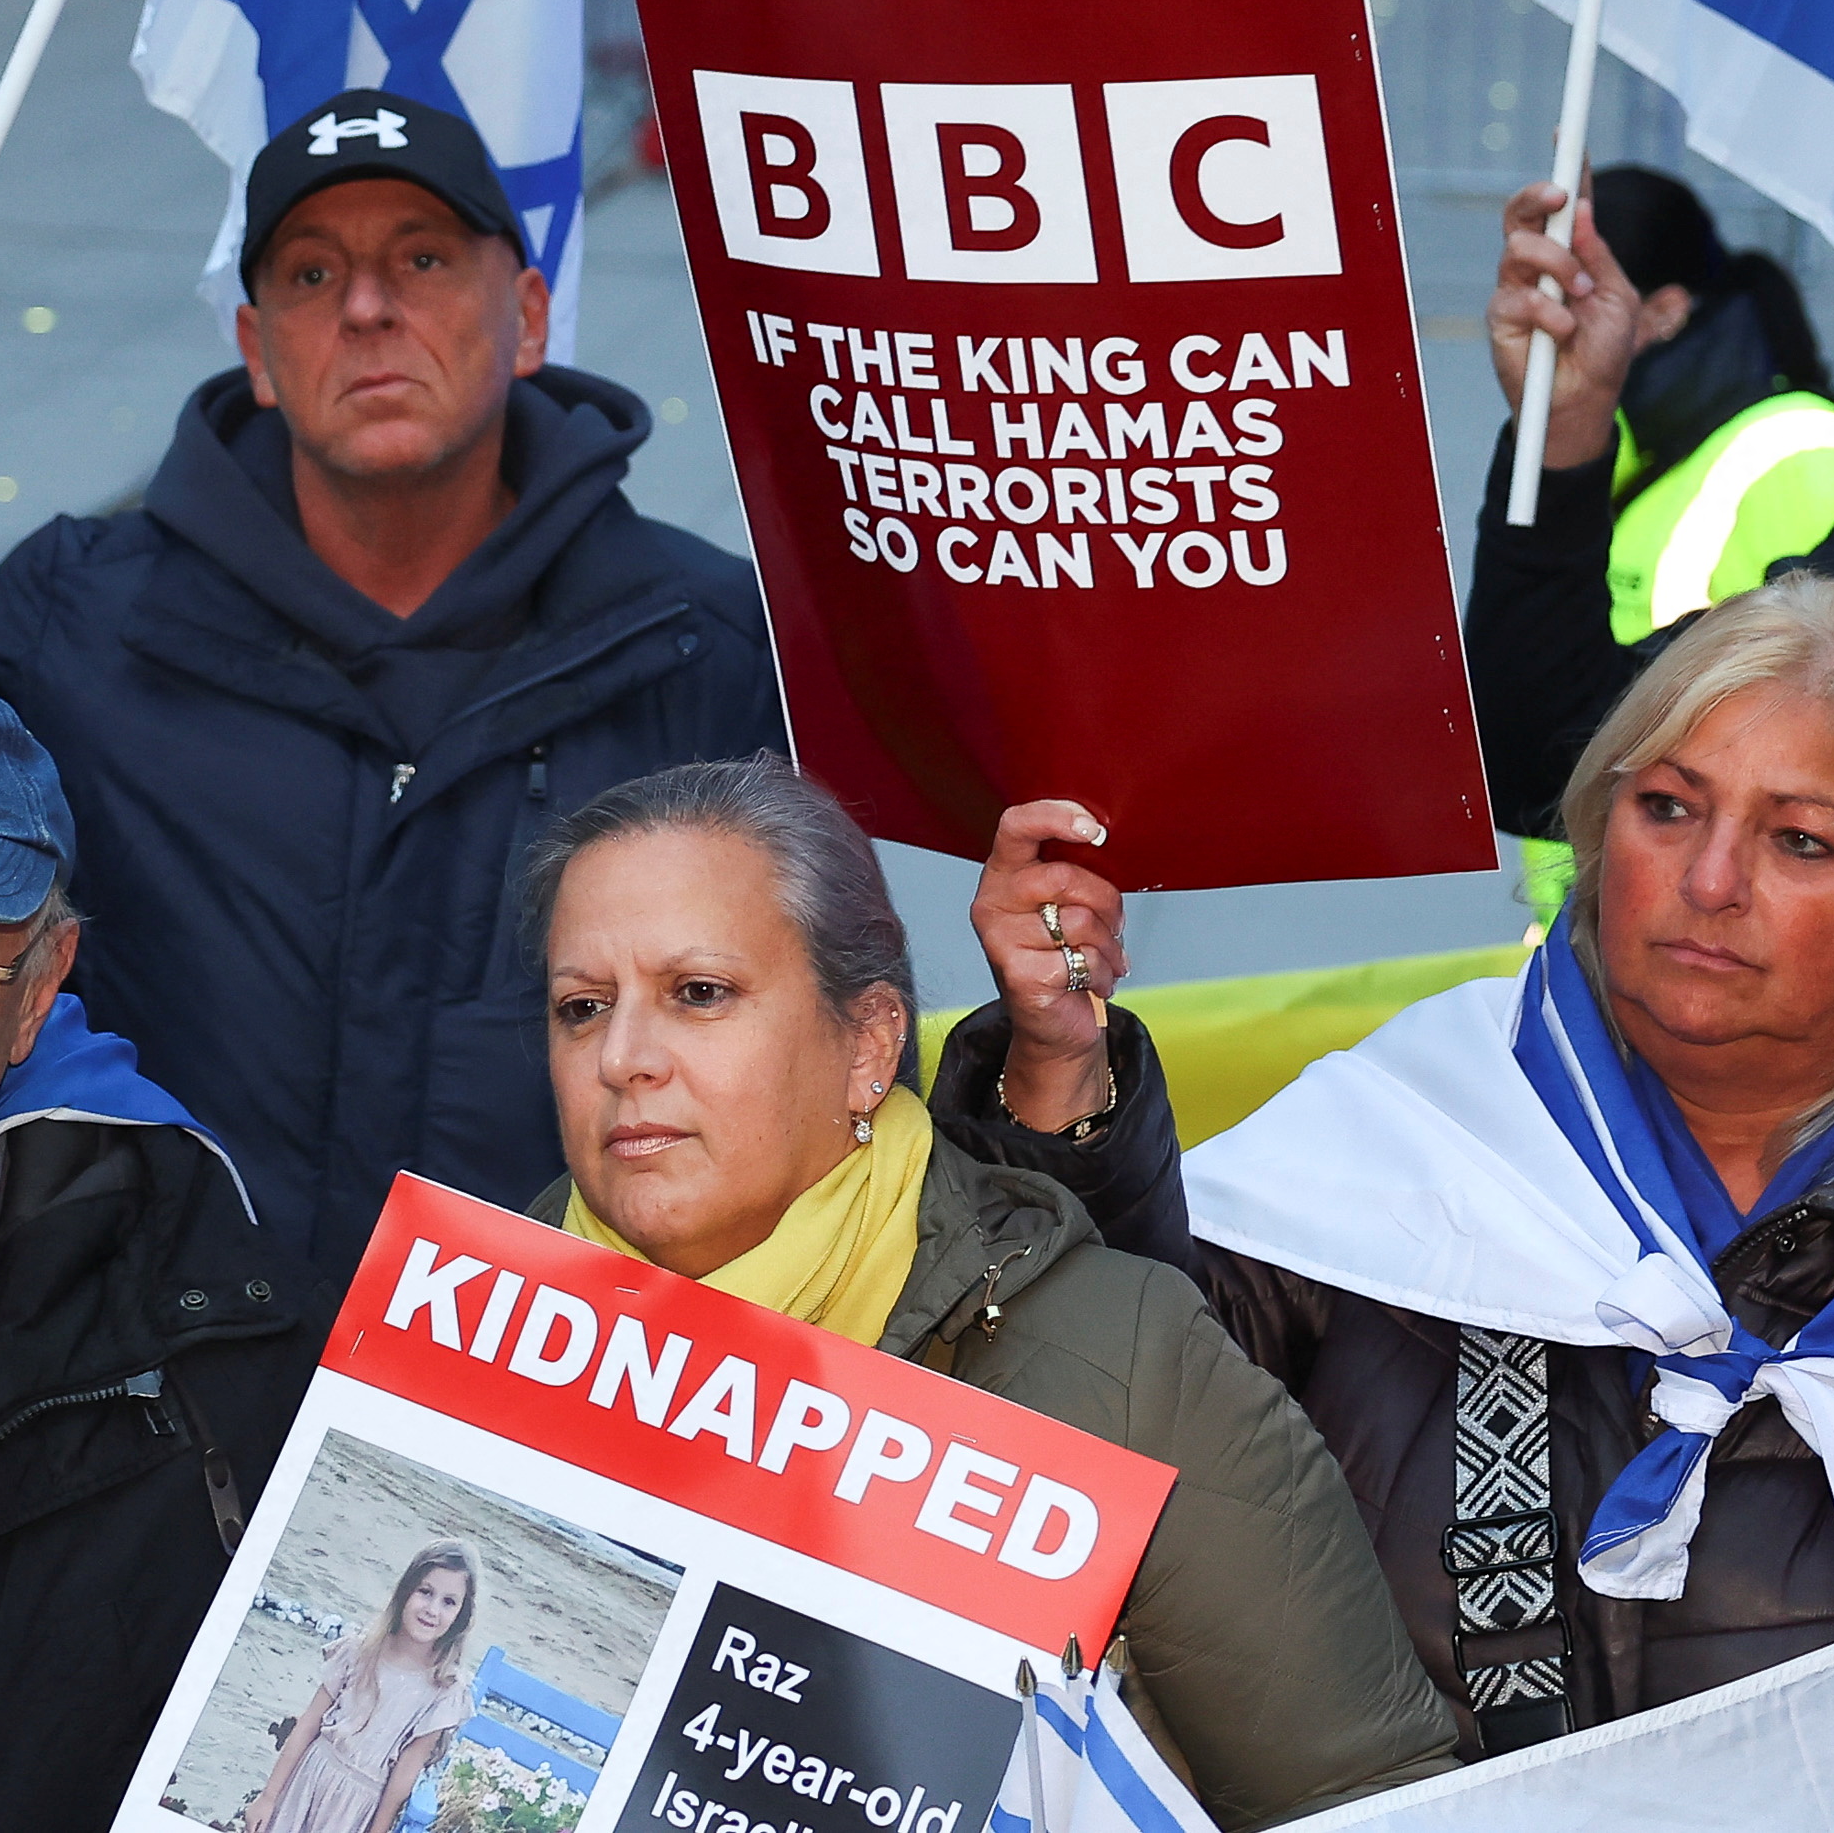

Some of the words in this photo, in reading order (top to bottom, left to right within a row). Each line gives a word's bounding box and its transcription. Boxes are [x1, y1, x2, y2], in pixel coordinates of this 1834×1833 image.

[740, 110, 1287, 253] BBC
[746, 309, 797, 366] IF
[807, 323, 939, 389] THE
[957, 335, 1146, 395] KING
[1170, 329, 1350, 393] CAN
[810, 383, 974, 456] CALL
[991, 399, 1284, 460] HAMAS
[827, 444, 1280, 523] TERRORISTS
[843, 507, 919, 573] SO
[937, 528, 1093, 589] CAN
[1111, 528, 1288, 589] YOU
[382, 1236, 1101, 1581] KIDNAPPED
[712, 1624, 811, 1704] Raz
[682, 1703, 963, 1833] 4-year-old
